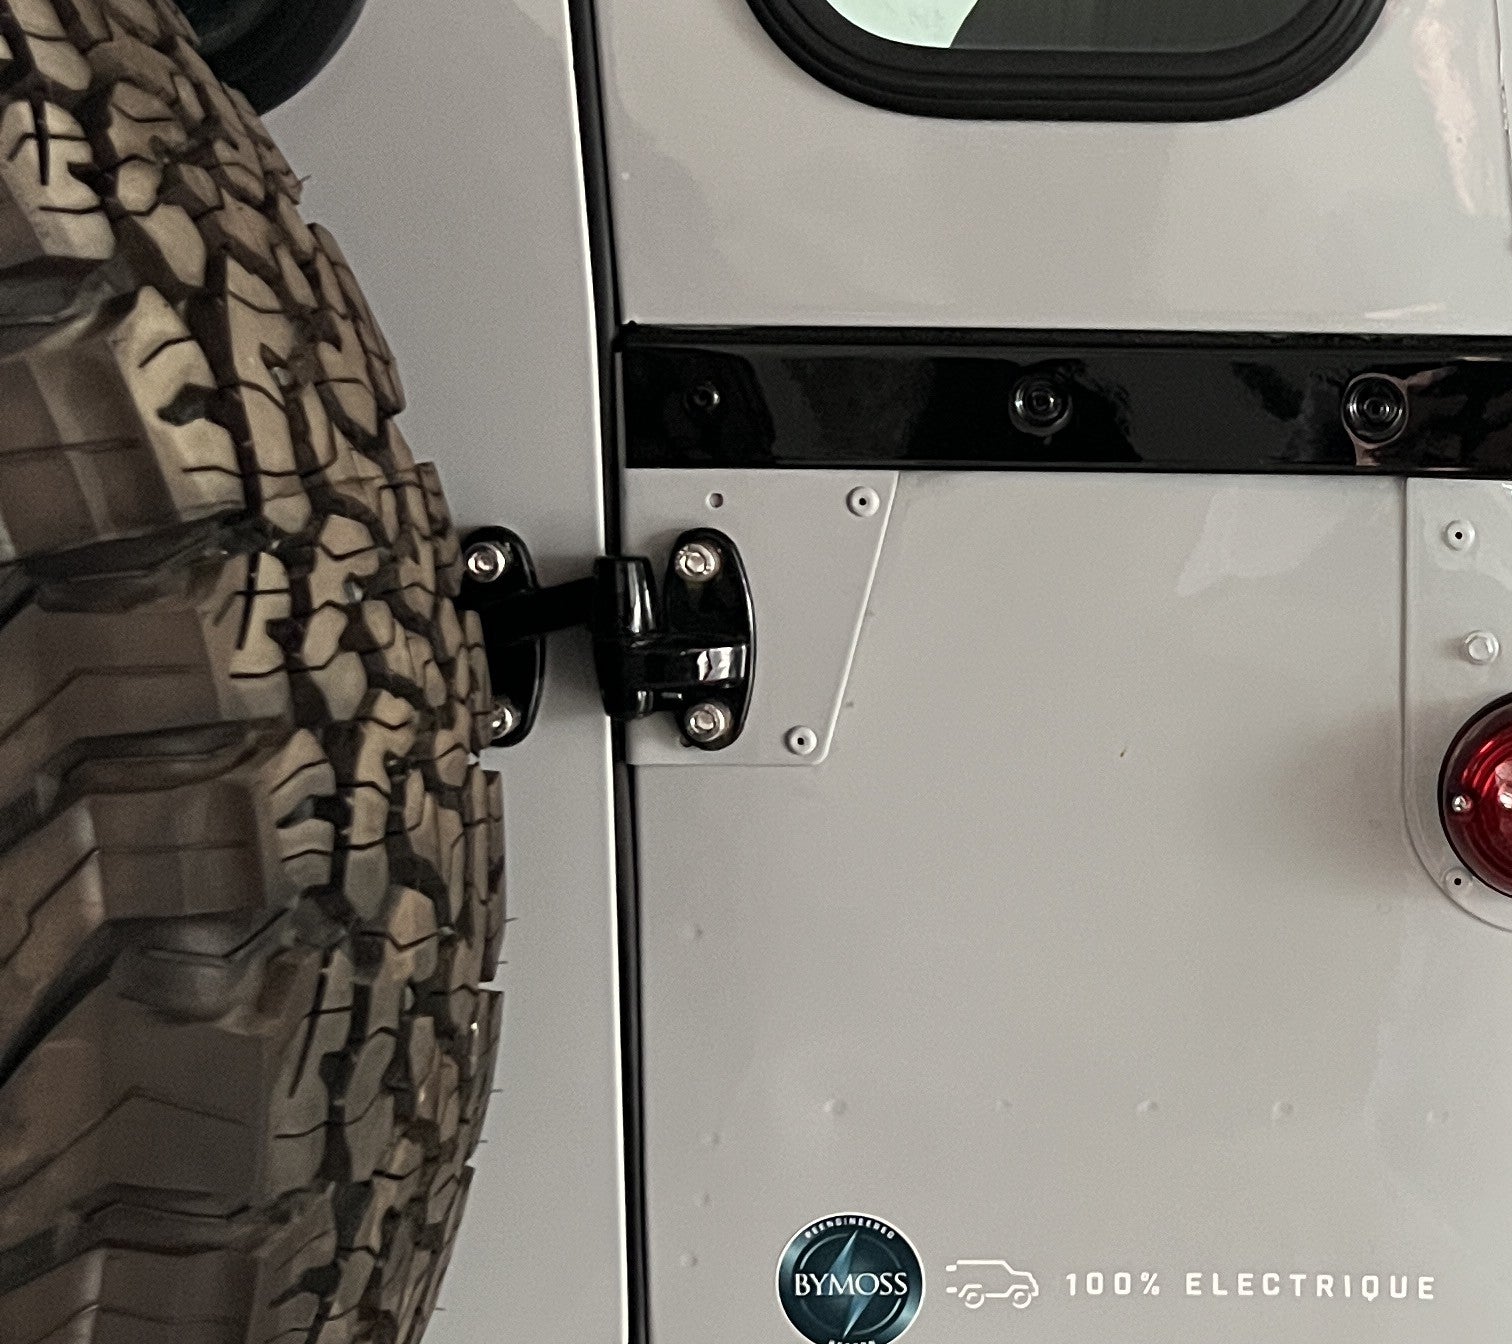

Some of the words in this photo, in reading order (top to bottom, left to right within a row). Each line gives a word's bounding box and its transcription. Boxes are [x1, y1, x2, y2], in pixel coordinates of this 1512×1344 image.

[795, 1272, 908, 1296] BYMOSS
[1066, 1272, 1162, 1297] 100%
[1185, 1271, 1436, 1302] ELECTRIQUE
